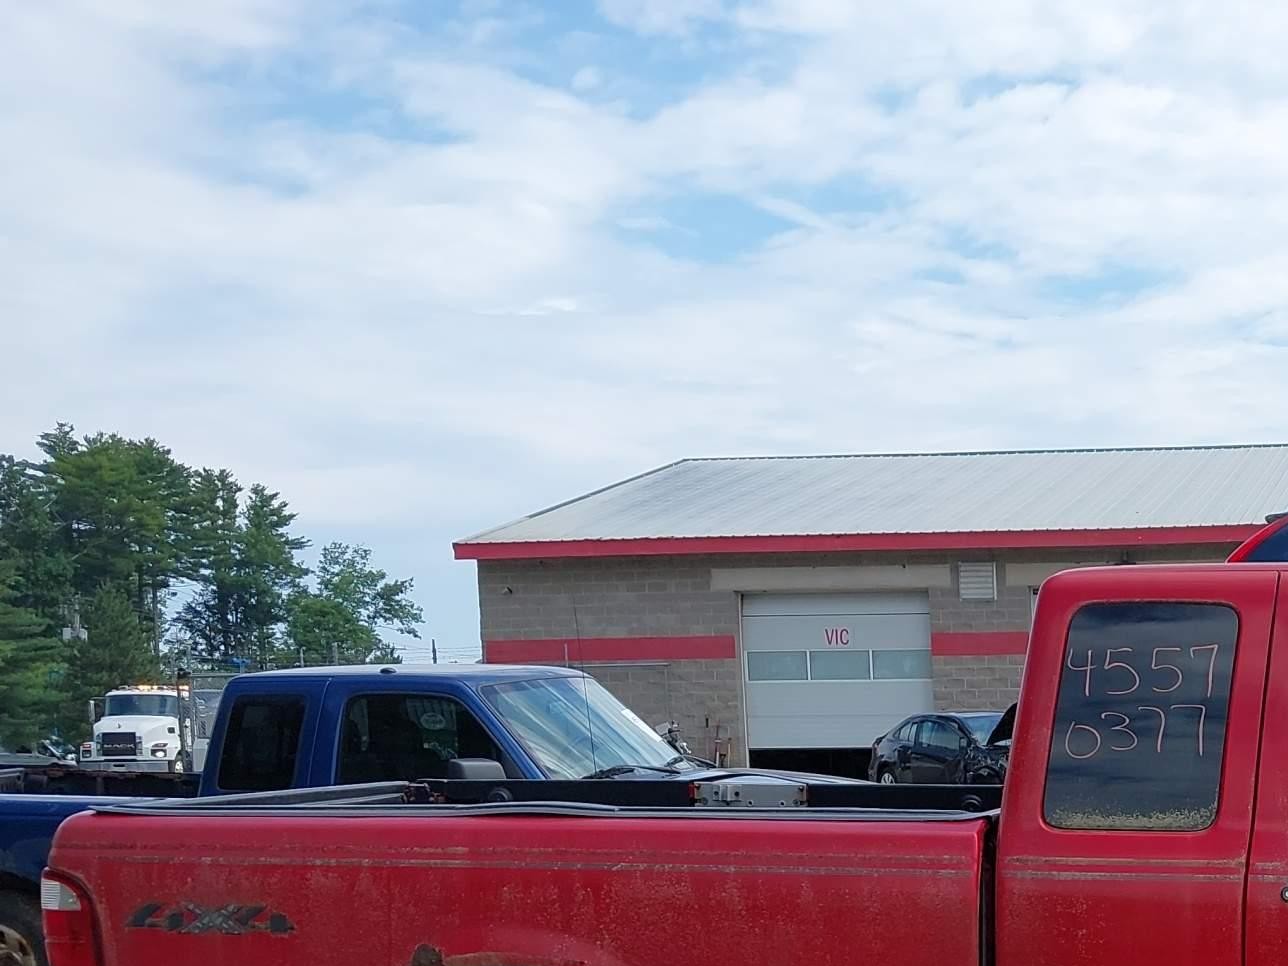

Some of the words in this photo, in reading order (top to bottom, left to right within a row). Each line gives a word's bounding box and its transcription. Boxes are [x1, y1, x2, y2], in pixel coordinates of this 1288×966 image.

[824, 628, 849, 645] VIC
[1066, 643, 1219, 698] 4557
[1064, 703, 1207, 760] 0377
